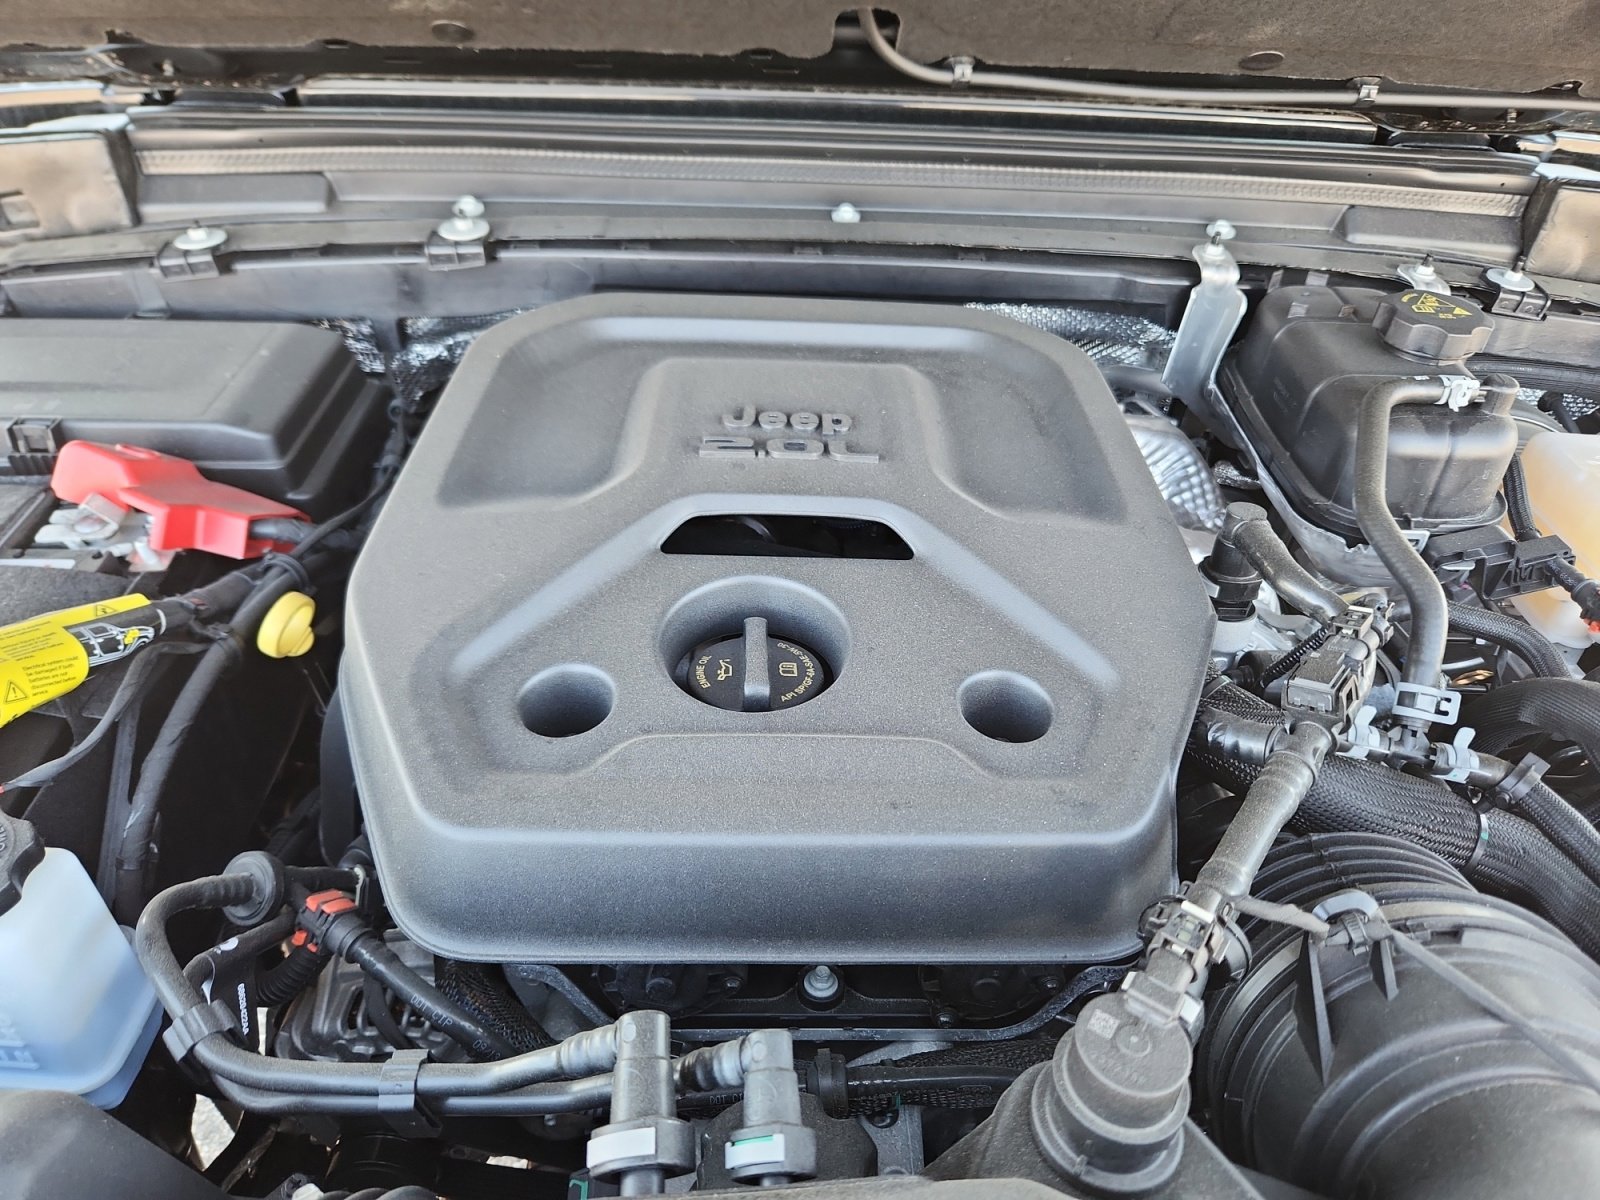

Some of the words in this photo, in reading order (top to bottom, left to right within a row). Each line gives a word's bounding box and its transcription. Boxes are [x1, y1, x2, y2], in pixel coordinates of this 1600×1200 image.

[721, 404, 854, 436] Jeep
[698, 436, 881, 464] 2.0L
[698, 655, 712, 665] OIL
[695, 665, 711, 689] ENGINE
[781, 691, 798, 702] API
[410, 994, 430, 1011] DOT
[432, 1010, 453, 1027] CIP
